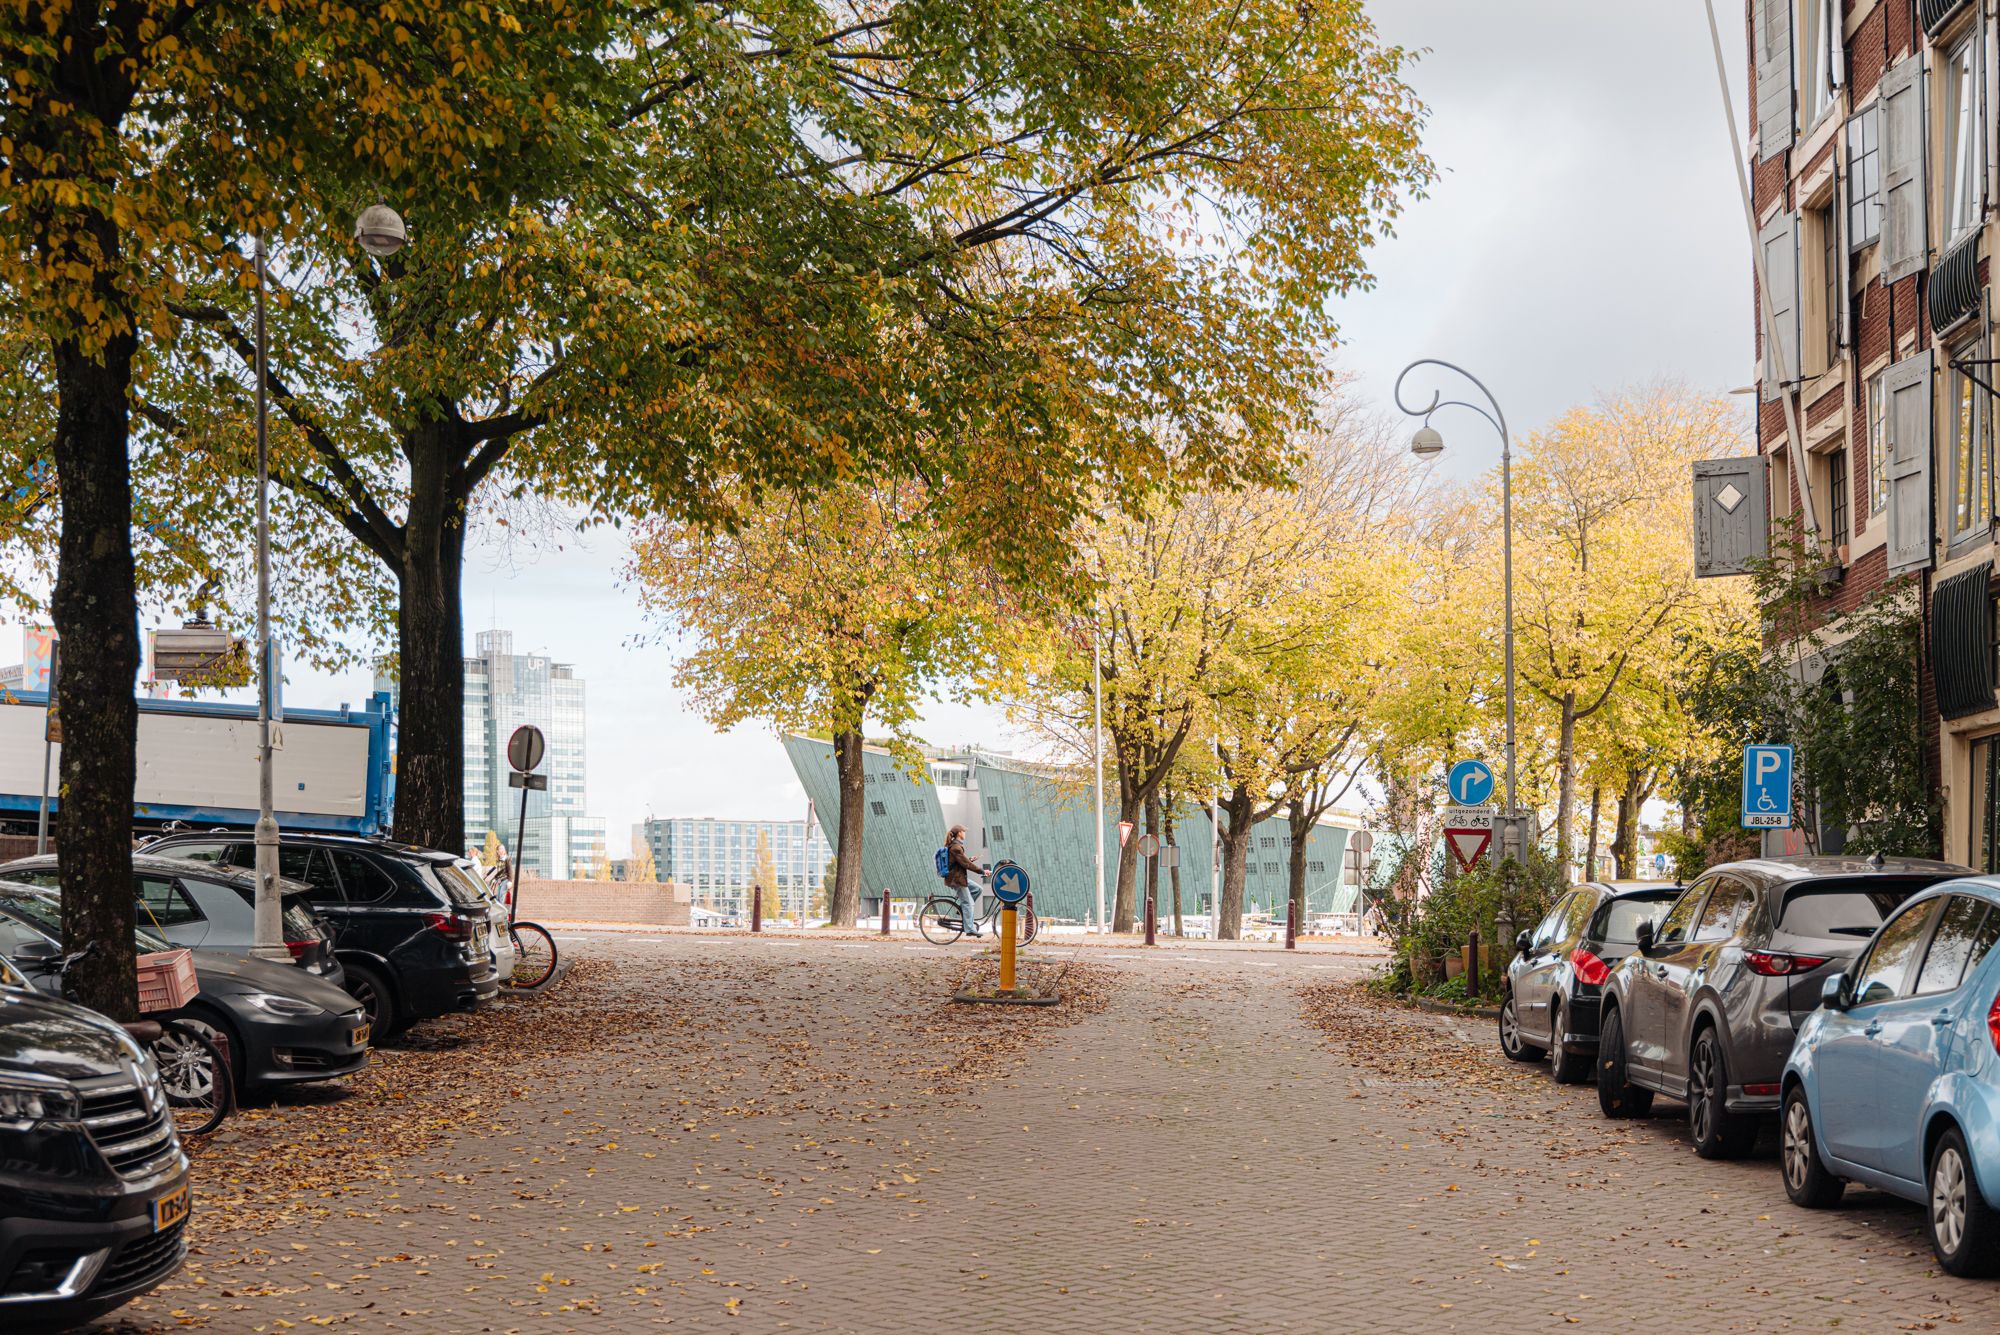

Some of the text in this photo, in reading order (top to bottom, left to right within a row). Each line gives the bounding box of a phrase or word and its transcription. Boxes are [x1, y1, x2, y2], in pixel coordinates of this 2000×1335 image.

[527, 657, 545, 670] UP
[1756, 751, 1781, 785] P
[1751, 816, 1782, 825] JBL-25-B
